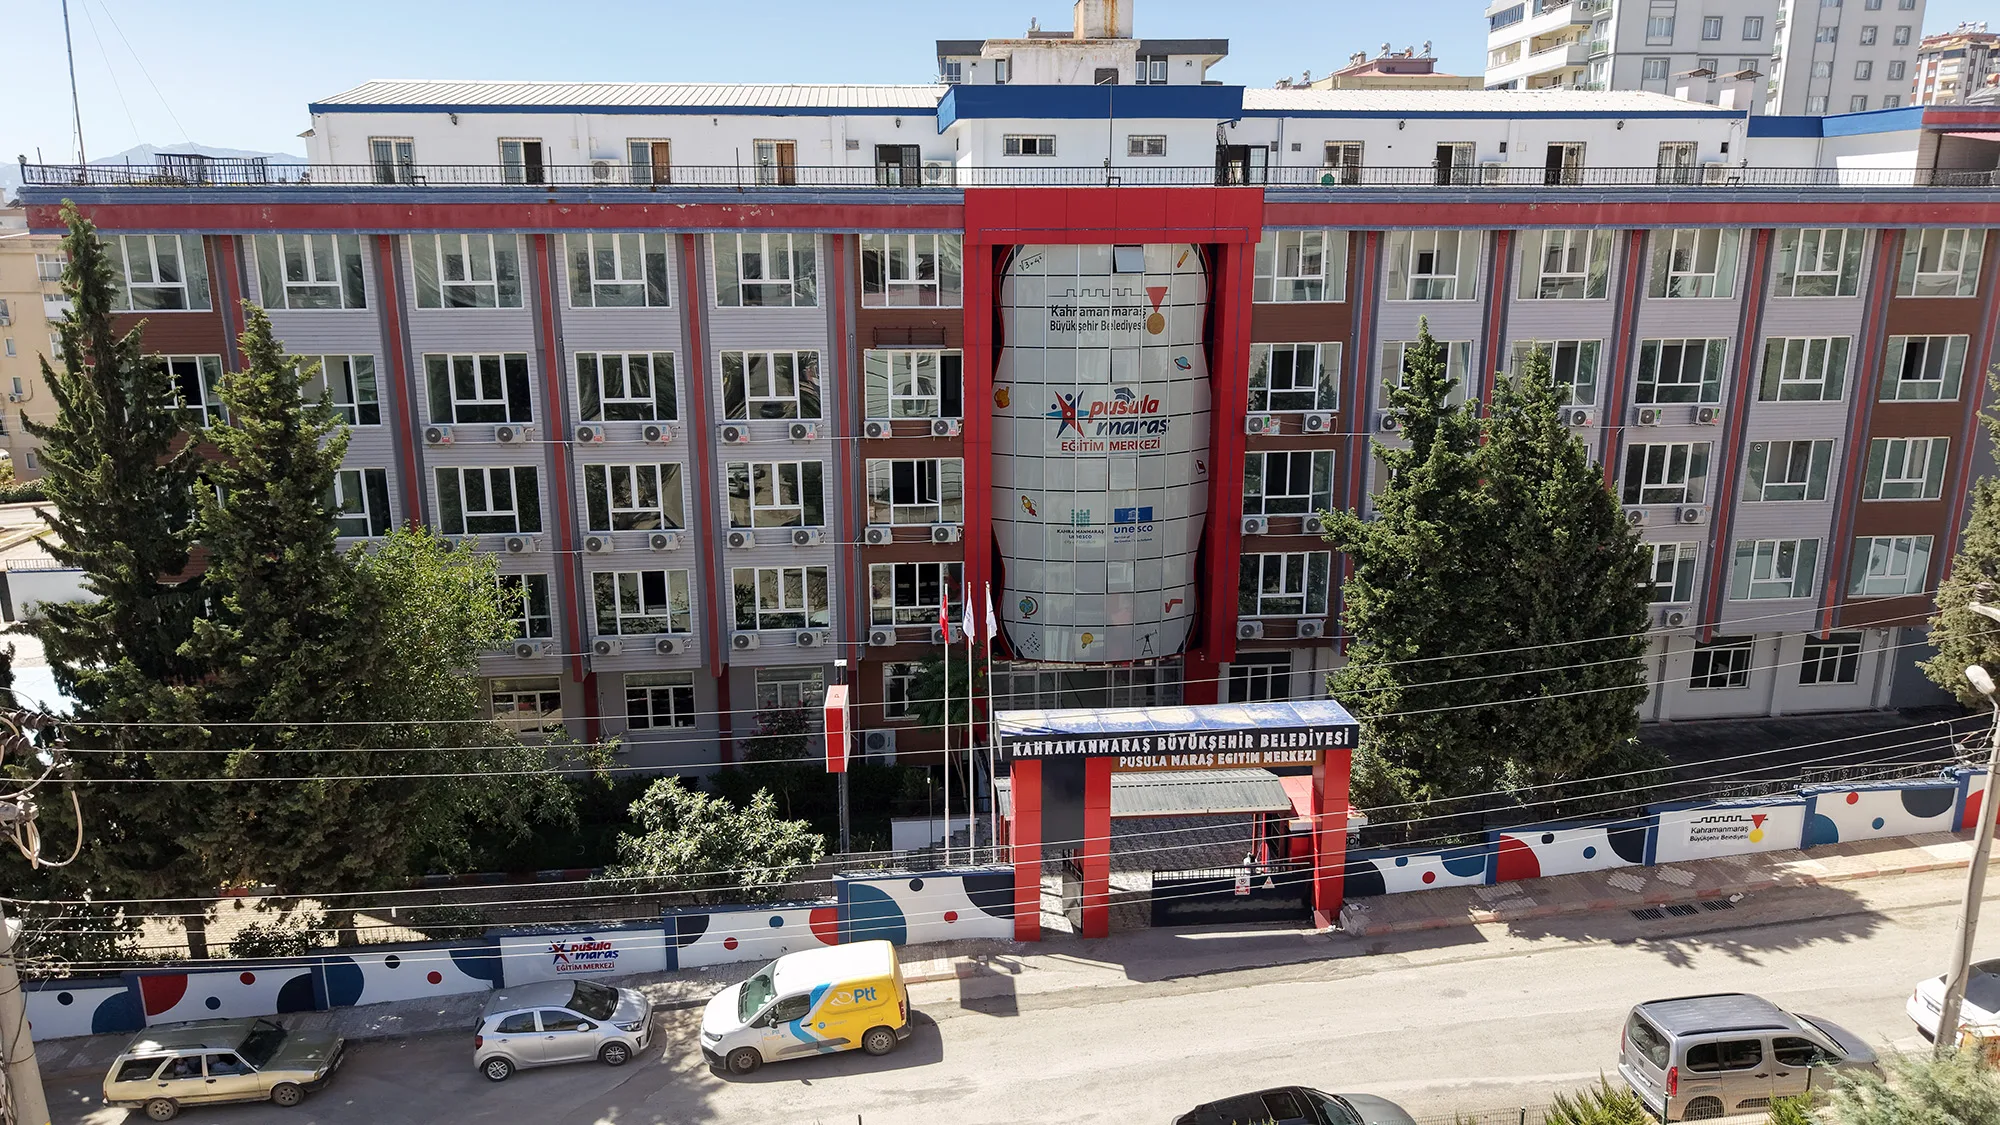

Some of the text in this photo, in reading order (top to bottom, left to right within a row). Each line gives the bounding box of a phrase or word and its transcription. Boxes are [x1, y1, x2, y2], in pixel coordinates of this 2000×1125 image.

[1050, 305, 1147, 320] Kahramanmaraş
[1050, 319, 1147, 333] Büyükşehir Belediyesi
[1088, 395, 1160, 424] pusula
[1096, 419, 1171, 435] maraş
[1061, 437, 1160, 452] EĞİTİM MERKEZİ
[1114, 524, 1154, 534] unesco
[1013, 728, 1349, 757] KAHRAMANMARAŞ BÜYÜKŞEHİR BELEDİYESİ
[1119, 755, 1168, 768] PUSULA
[1171, 753, 1214, 767] MARAŞ
[1690, 825, 1749, 834] Kahramanmaraş
[570, 941, 612, 956] pusula
[583, 962, 615, 970] MERKEZİ
[854, 986, 877, 1003] Ptt
